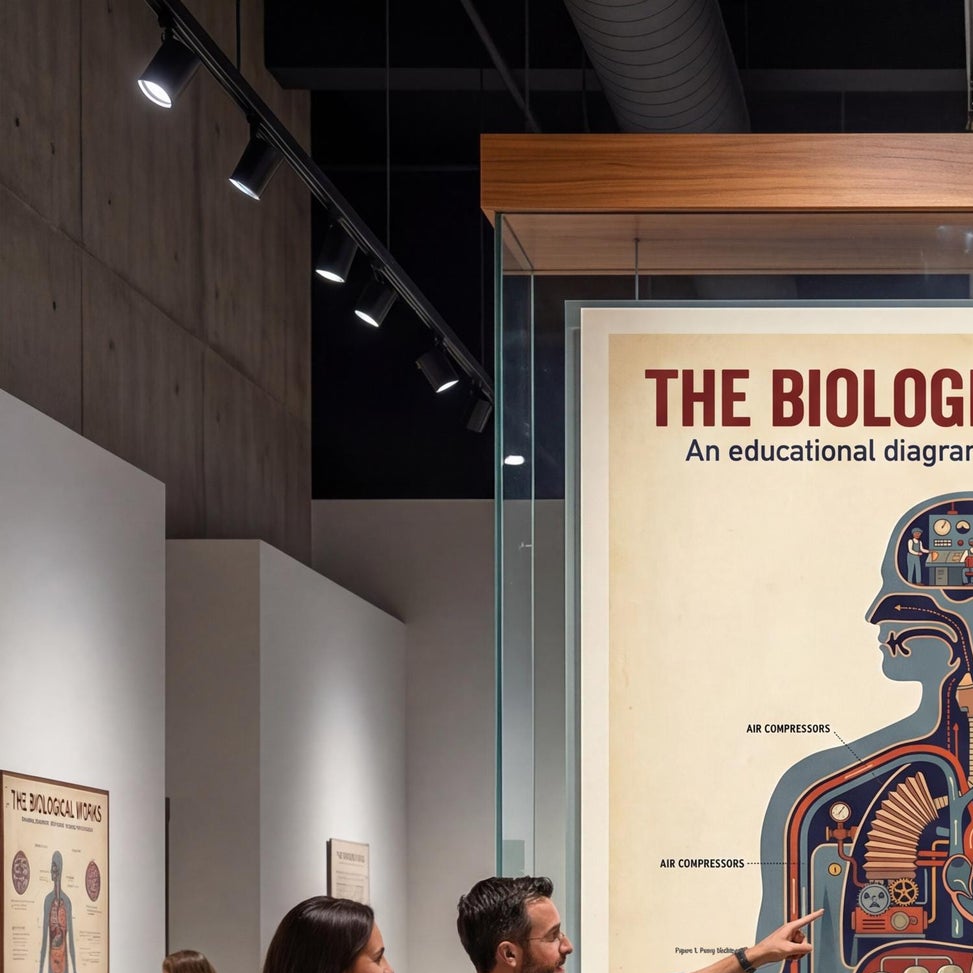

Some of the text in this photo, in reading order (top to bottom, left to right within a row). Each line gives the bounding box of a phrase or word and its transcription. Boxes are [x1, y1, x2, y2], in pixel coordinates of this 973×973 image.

[644, 368, 751, 427] THE
[685, 438, 720, 462] An
[728, 438, 876, 462] educational
[746, 723, 831, 734] AIR COMPRESSORS
[659, 858, 745, 869] AIR COMPRESSORS
